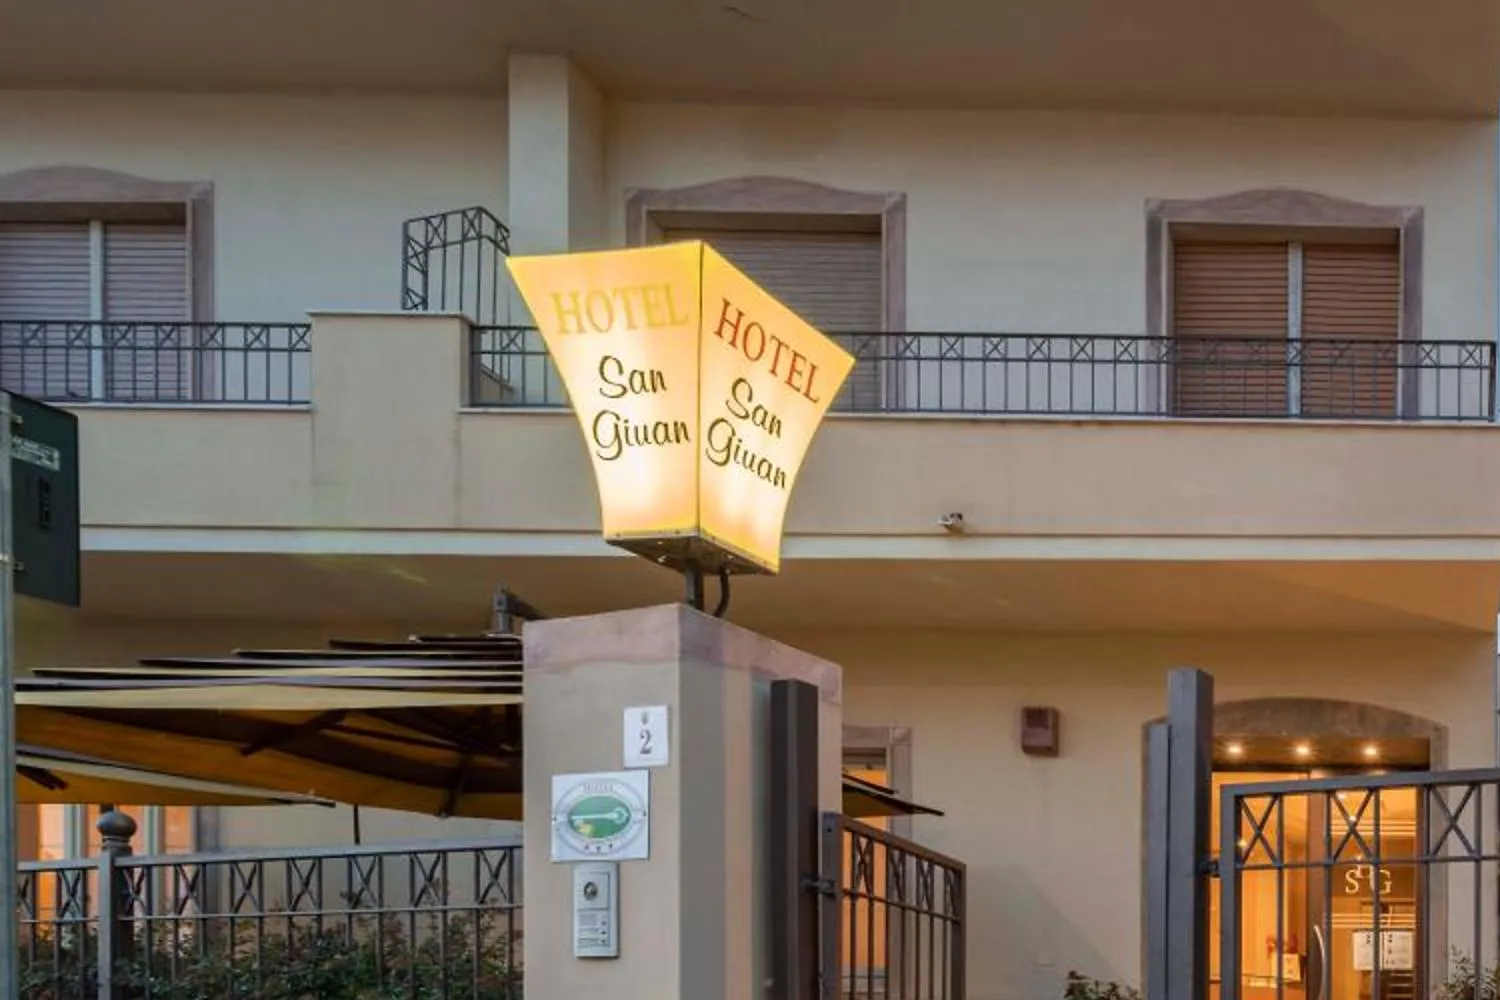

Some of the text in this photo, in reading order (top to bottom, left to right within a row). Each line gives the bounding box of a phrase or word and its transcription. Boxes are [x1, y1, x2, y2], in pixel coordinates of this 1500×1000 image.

[551, 284, 688, 334] HOTEL
[715, 299, 820, 403] HOTEL
[599, 355, 667, 399] San
[726, 377, 783, 438] San
[593, 410, 690, 460] Giuan
[705, 418, 786, 489] Giuan
[640, 729, 651, 754] 2
